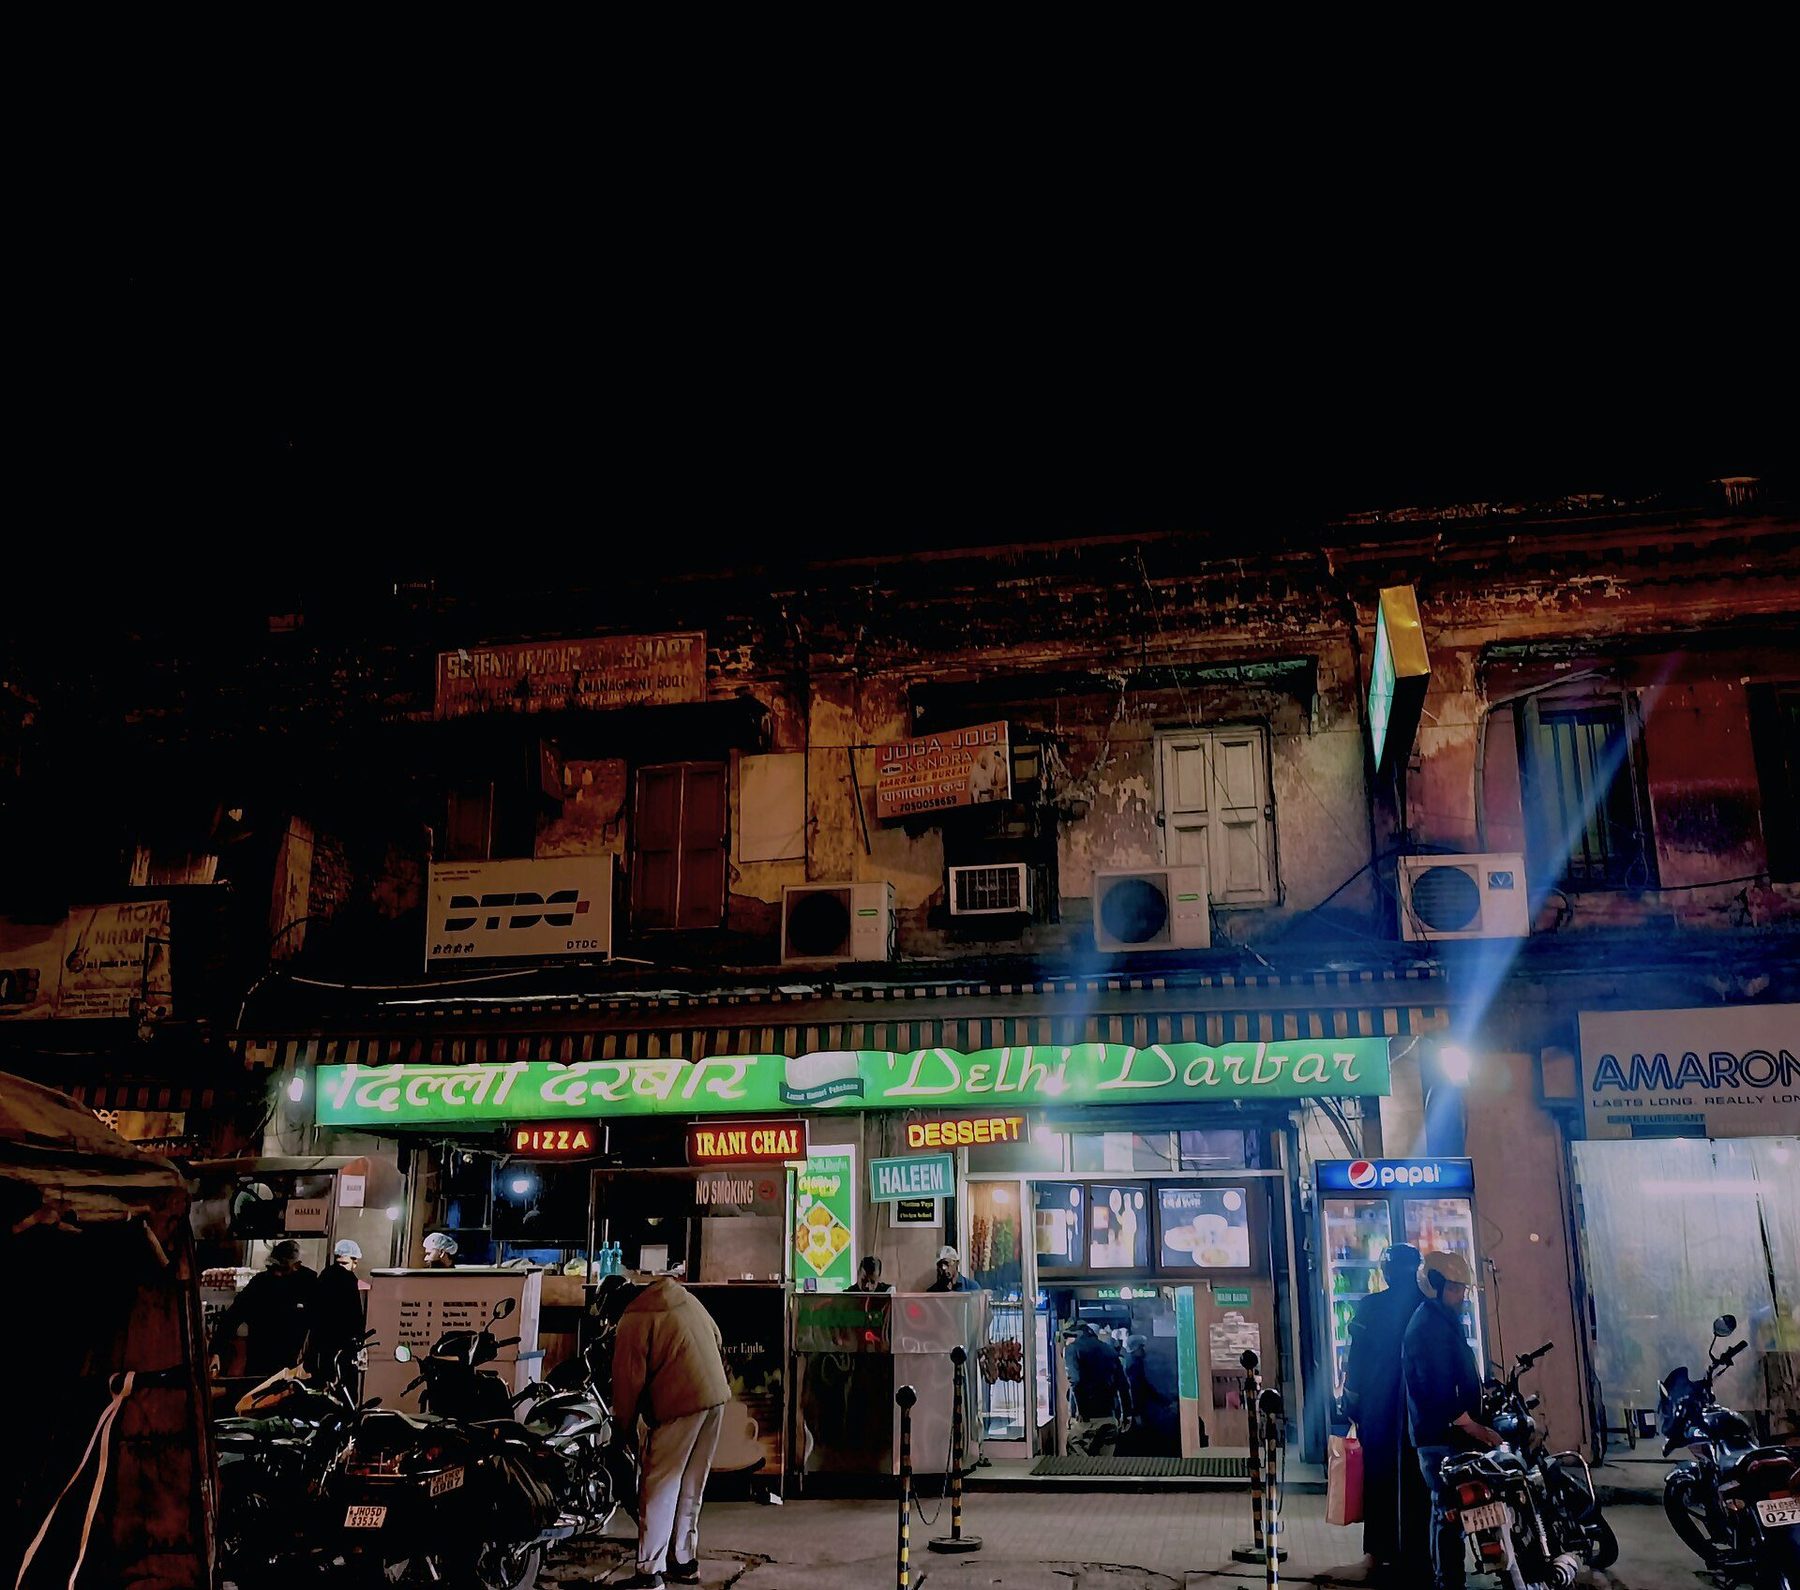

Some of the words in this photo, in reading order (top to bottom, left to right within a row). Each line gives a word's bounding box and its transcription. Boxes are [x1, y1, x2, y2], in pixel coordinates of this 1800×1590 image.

[905, 751, 972, 773] KENDRA
[932, 766, 970, 779] BUREAU
[445, 890, 579, 931] DTDC
[566, 940, 598, 949] DTDC
[540, 1057, 758, 1106] दरबार
[883, 1045, 1072, 1097] Delhi
[1098, 1043, 1361, 1089] Darbar
[1592, 1049, 1800, 1092] AMARON
[1593, 1097, 1643, 1108] LASTS
[1704, 1095, 1766, 1105] REALLY
[516, 1131, 590, 1151] PIZZA
[696, 1131, 748, 1157] IRANI
[751, 1129, 799, 1155] CHAI
[908, 1117, 1024, 1148] DESSERT
[879, 1163, 944, 1195] HALEEM
[1380, 1163, 1440, 1187] pepsi
[695, 1181, 709, 1205] NO
[711, 1179, 754, 1204] SMOKING
[1766, 1510, 1800, 1523] 027
